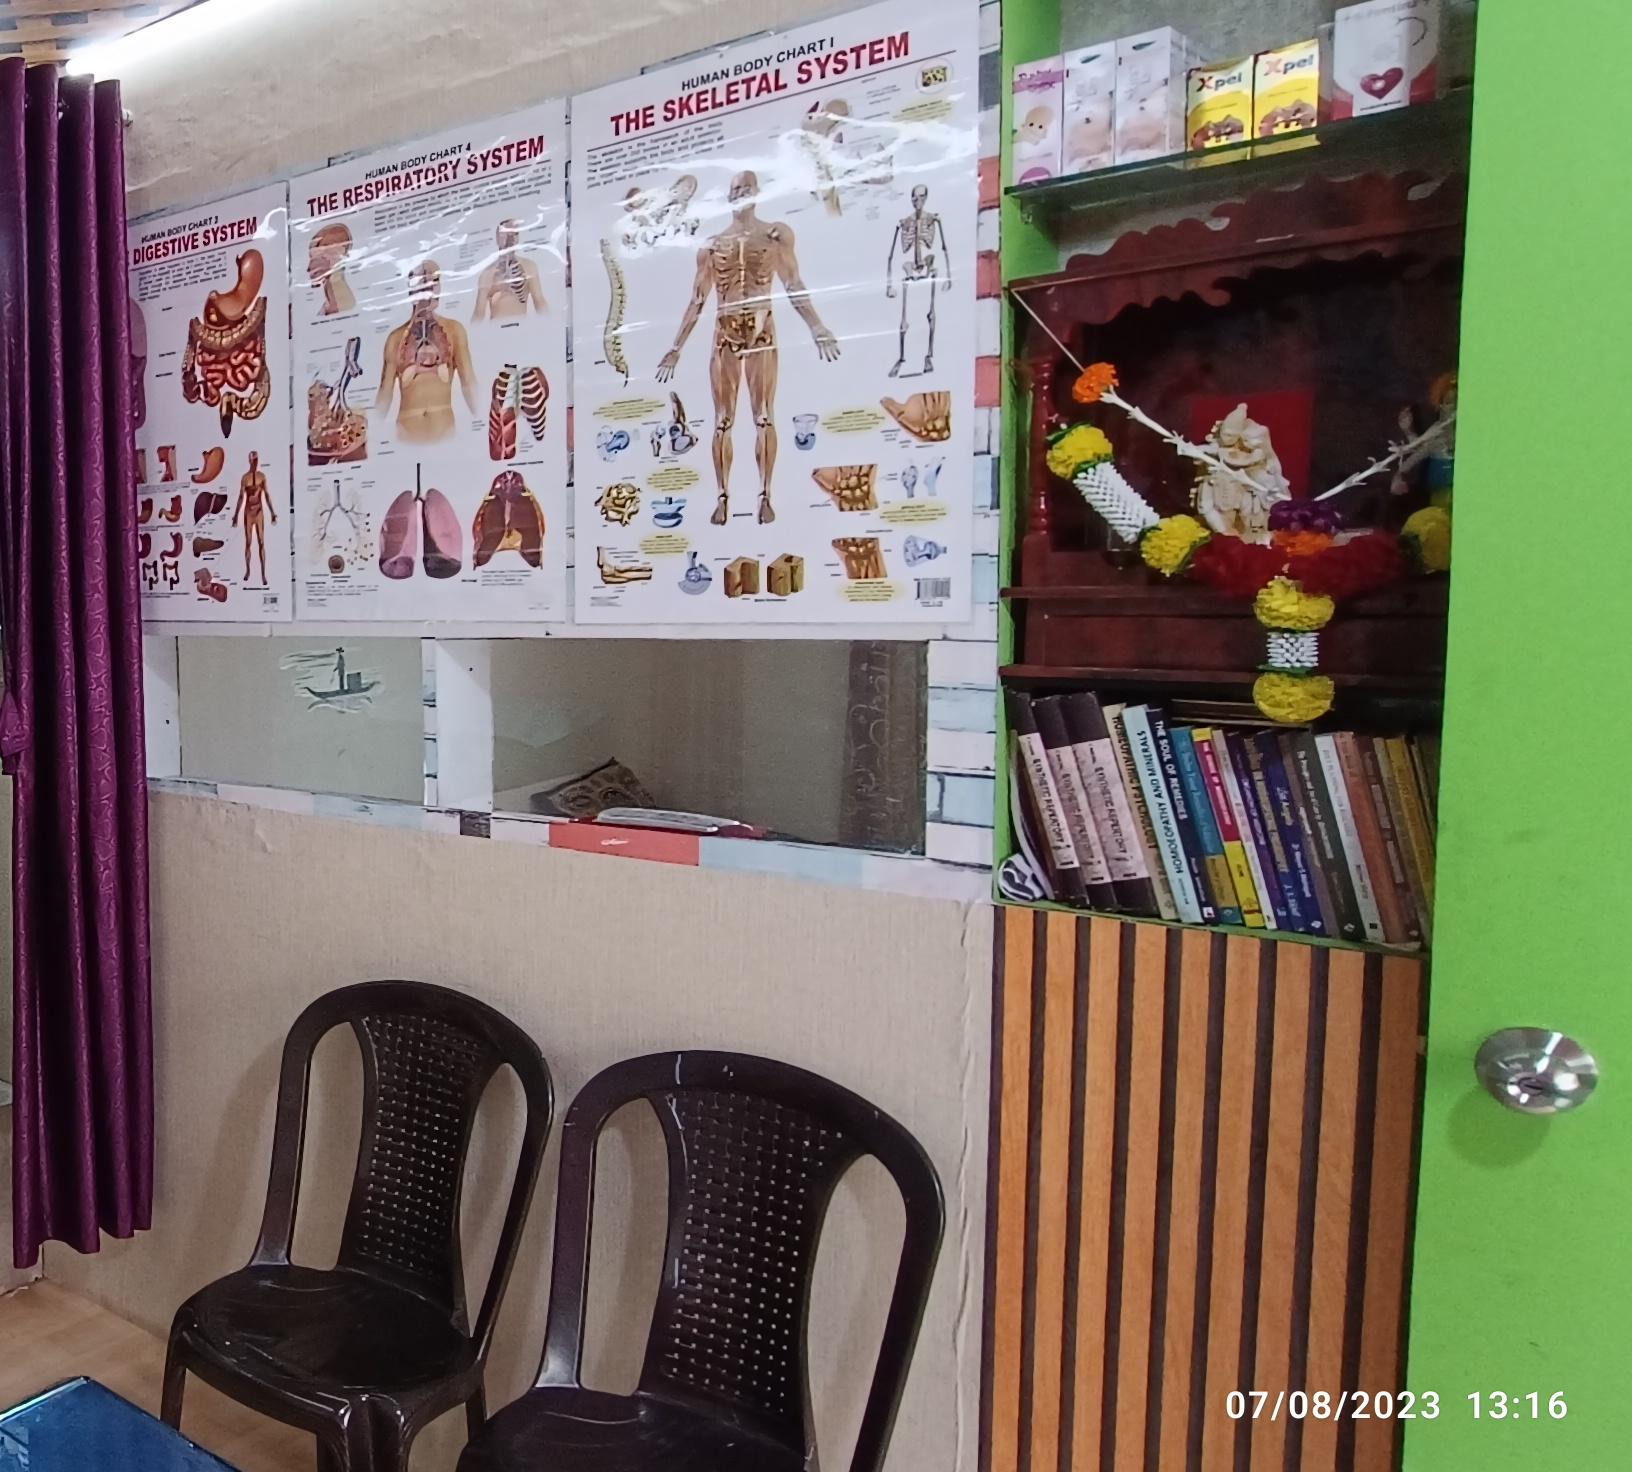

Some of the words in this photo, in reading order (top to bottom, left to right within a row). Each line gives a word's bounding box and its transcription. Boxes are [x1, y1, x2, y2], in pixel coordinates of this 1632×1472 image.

[610, 105, 655, 136] THE
[663, 69, 788, 122] SKELETAL
[797, 31, 910, 85] SYSTEM
[681, 69, 730, 91] HUMAN
[733, 54, 774, 76] BODY
[776, 38, 827, 63] CHART
[1196, 72, 1243, 92] Xpel
[306, 195, 339, 217] THE
[342, 157, 462, 208] RESPIRATORY
[467, 135, 544, 175] SYSTEM
[365, 163, 399, 180] HUMAN
[400, 156, 428, 170] BODY
[429, 144, 464, 162] CHART
[133, 233, 199, 265] DIGESTIVE
[202, 216, 258, 247] SYSTEM
[167, 225, 187, 237] BODY
[188, 217, 213, 230] CHART
[1154, 720, 1167, 737] THE
[1137, 731, 1157, 777] MINERALS
[1159, 739, 1173, 762] SOUL
[1165, 763, 1177, 776] OF
[1150, 778, 1164, 799] AND
[1169, 778, 1188, 820] REMEDIES
[1157, 801, 1184, 874] HOMOEOPATHY
